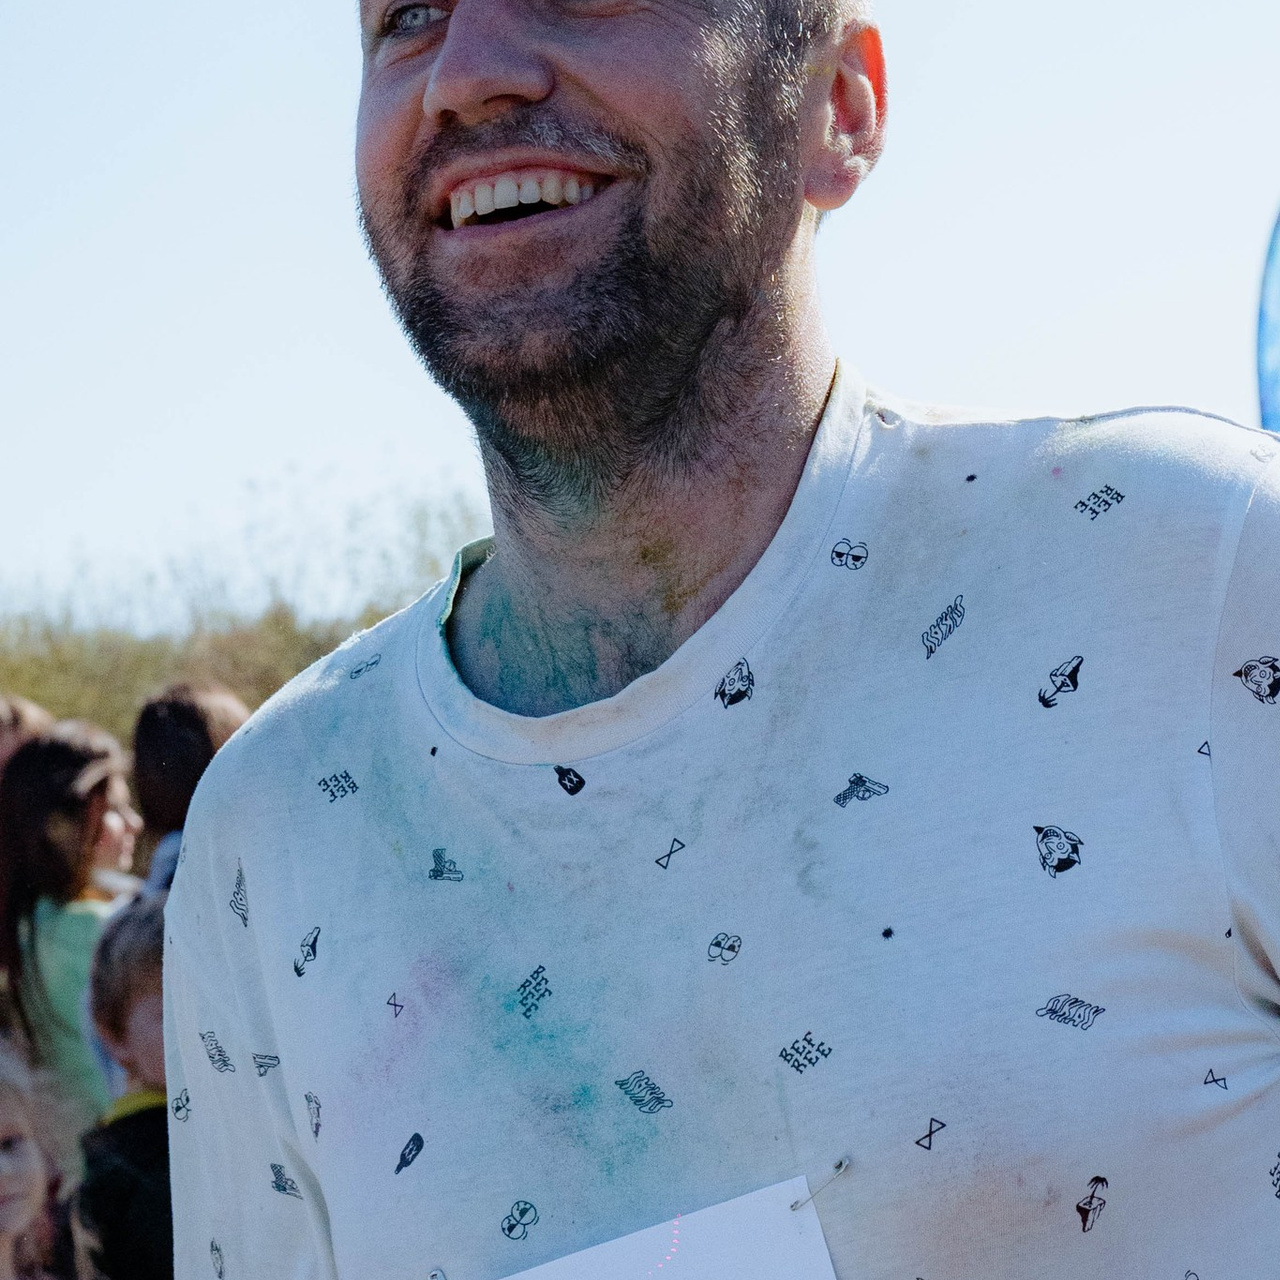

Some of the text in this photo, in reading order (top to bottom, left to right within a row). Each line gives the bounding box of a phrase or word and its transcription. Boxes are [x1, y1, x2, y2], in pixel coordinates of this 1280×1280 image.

[1073, 484, 1116, 514] REE
[1090, 490, 1125, 521] BEF
[317, 770, 352, 793] REE
[328, 780, 360, 803] BEF
[516, 979, 539, 1020] REE
[530, 965, 553, 1002] BEF
[779, 1031, 815, 1065] BEF
[791, 1042, 833, 1075] REE
